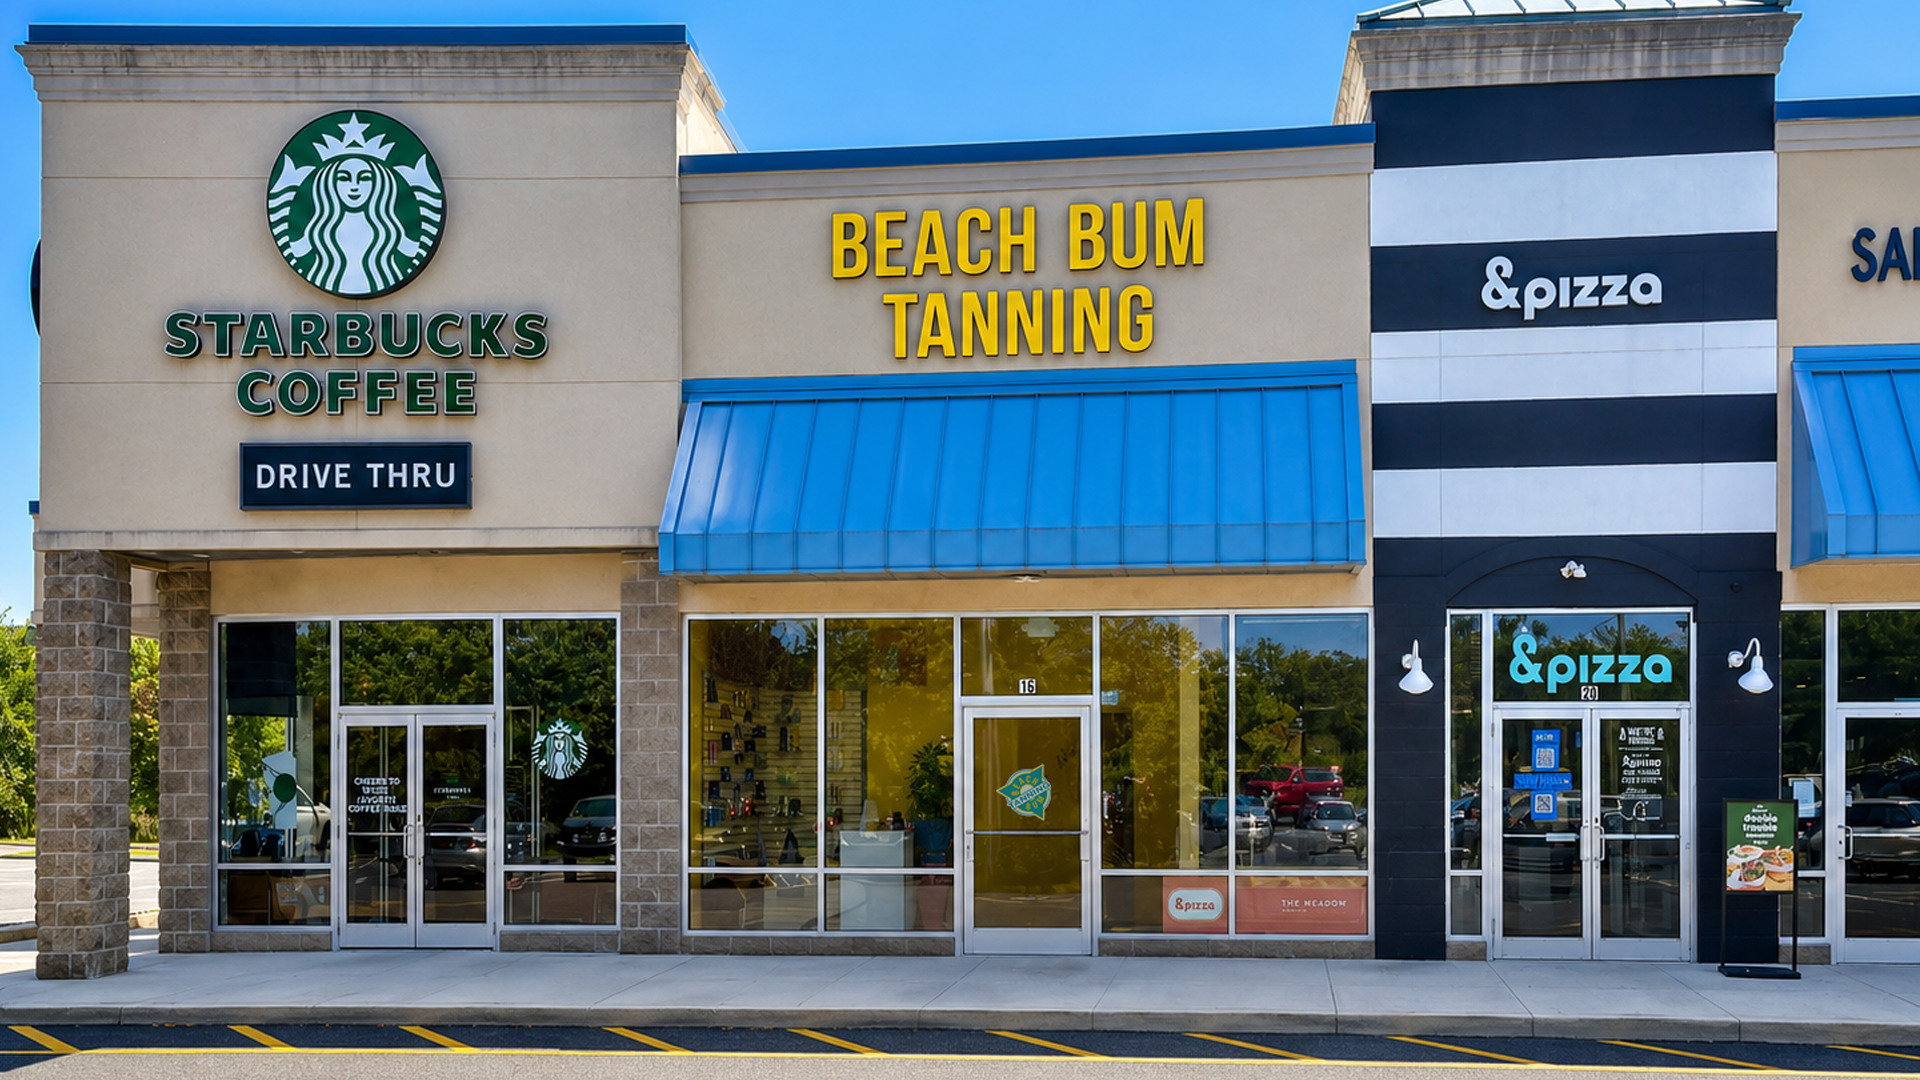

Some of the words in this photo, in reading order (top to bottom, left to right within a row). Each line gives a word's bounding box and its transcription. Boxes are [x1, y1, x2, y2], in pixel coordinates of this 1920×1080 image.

[831, 205, 1037, 279] BEACH
[1068, 197, 1205, 271] BUM
[1480, 255, 1663, 321] &pizza
[164, 309, 549, 360] STARBUCKS
[882, 284, 1155, 359] TANNING
[236, 369, 478, 417] COFFEE
[256, 463, 352, 489] DRIVE
[366, 462, 457, 489] THRU
[1021, 679, 1035, 693] 16
[1509, 633, 1673, 694] &pizza
[1582, 686, 1597, 701] 20
[1007, 781, 1051, 809] TANNING
[1281, 899, 1300, 908] THE
